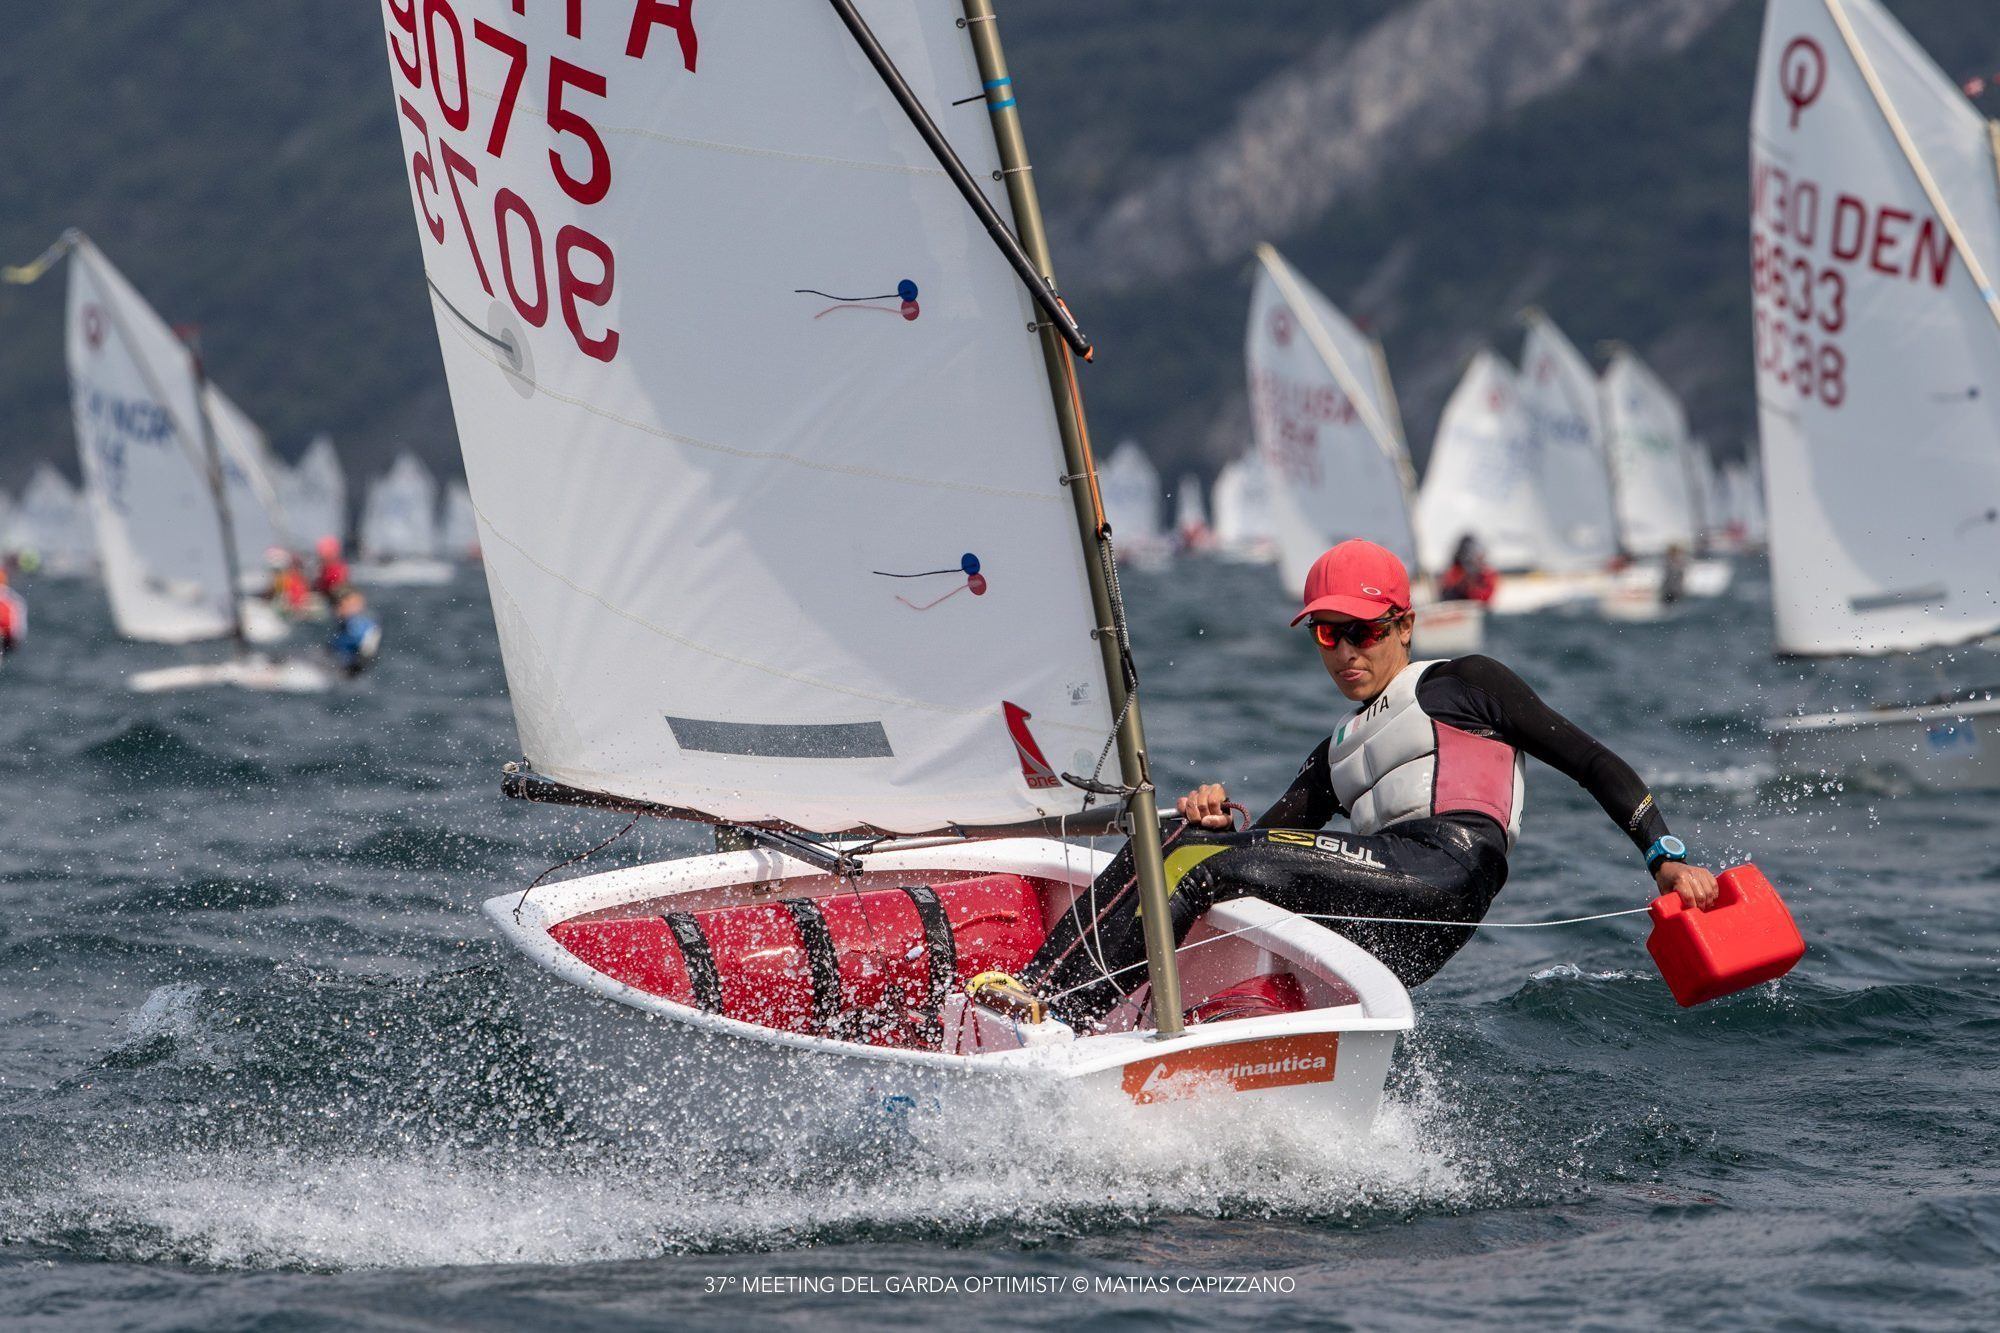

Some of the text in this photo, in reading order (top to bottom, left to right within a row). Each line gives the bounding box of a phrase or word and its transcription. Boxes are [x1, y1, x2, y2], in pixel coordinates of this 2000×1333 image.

[381, 0, 612, 205] 9075
[1831, 193, 1954, 288] DEN
[1366, 695, 1390, 722] ITA
[1315, 835, 1386, 870] GUL
